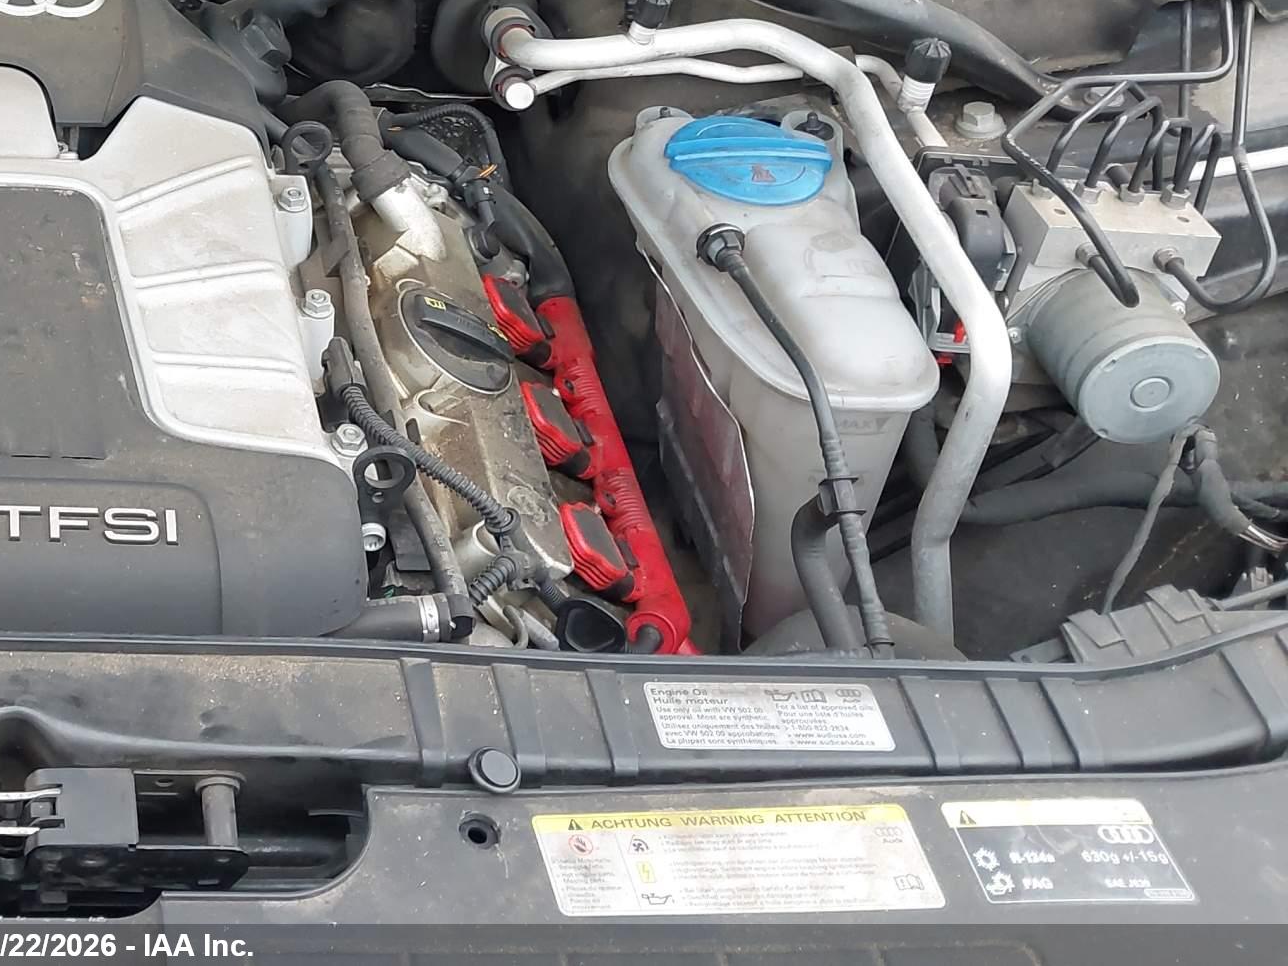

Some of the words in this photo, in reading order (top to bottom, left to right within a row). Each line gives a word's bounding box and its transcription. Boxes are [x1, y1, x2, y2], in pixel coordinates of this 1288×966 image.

[651, 688, 689, 698] Engine
[653, 697, 682, 705] Huile
[686, 697, 729, 705] moteur
[673, 706, 690, 714] only
[591, 817, 672, 829] ACHTUNG
[680, 814, 765, 827] WARNING
[775, 810, 867, 824] ATTENTION
[1081, 850, 1120, 865] 630g
